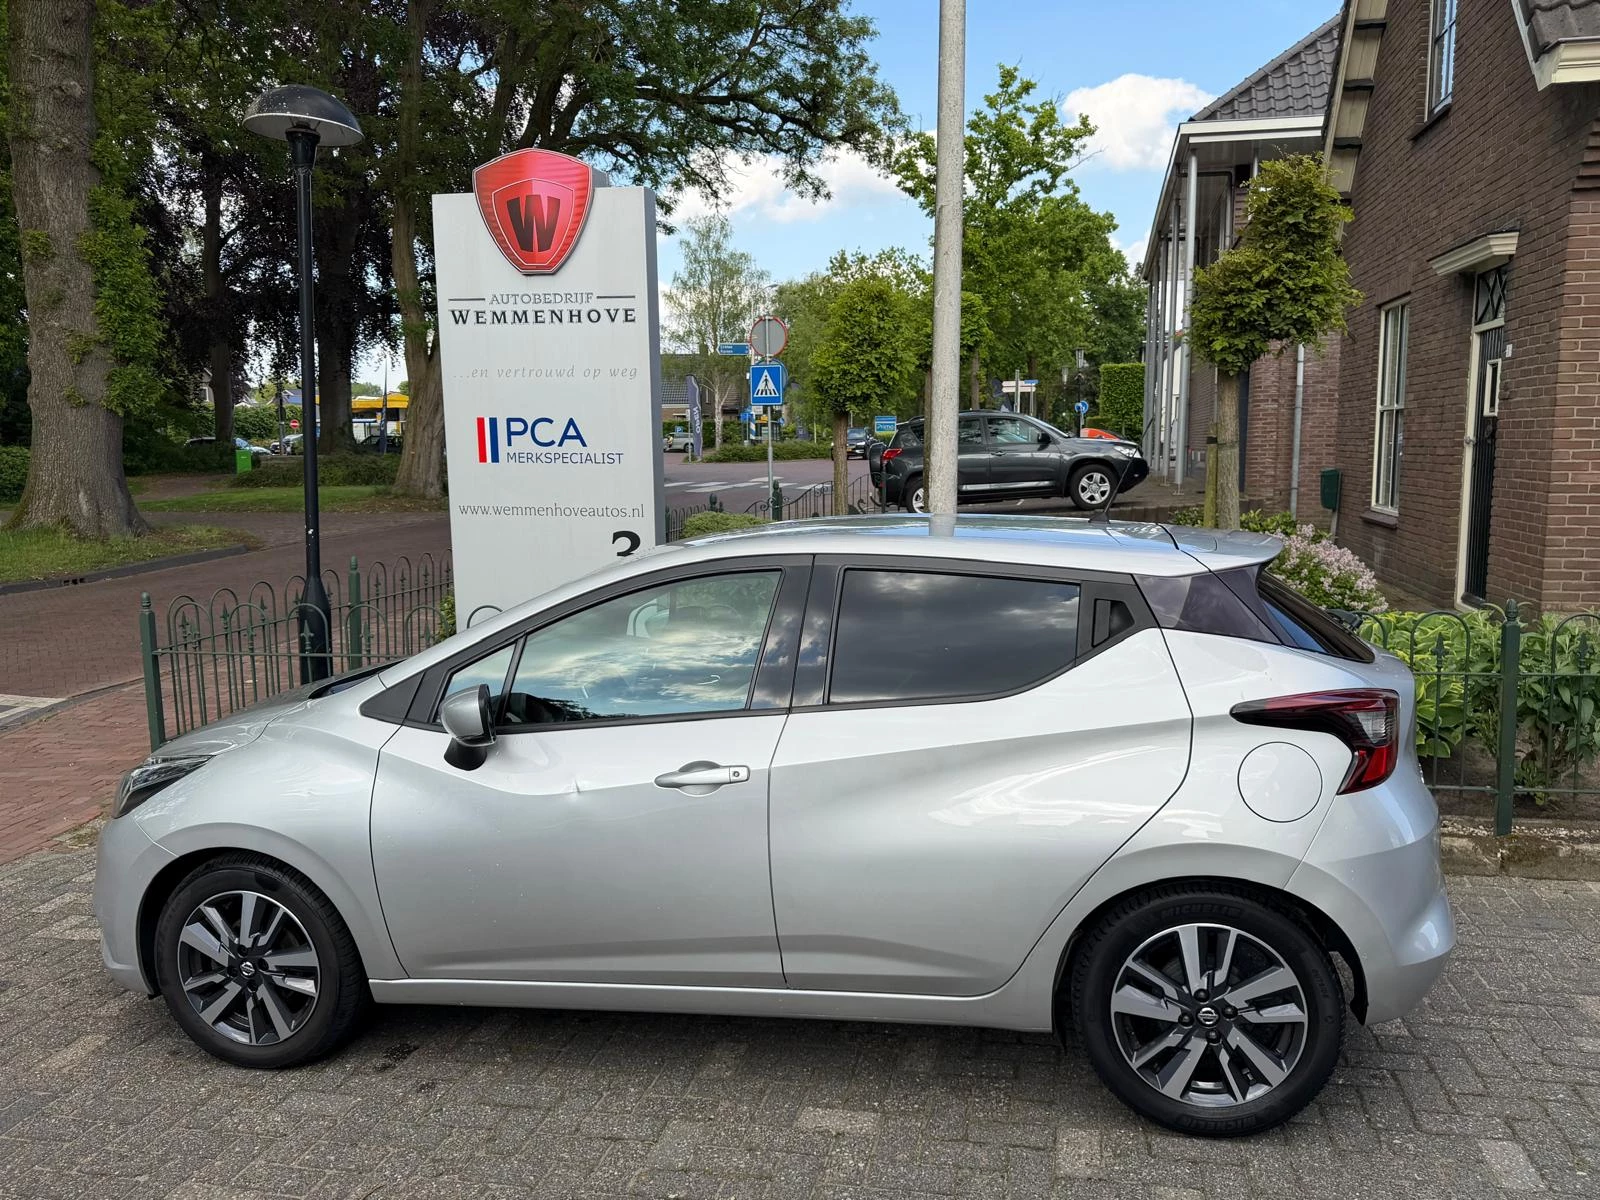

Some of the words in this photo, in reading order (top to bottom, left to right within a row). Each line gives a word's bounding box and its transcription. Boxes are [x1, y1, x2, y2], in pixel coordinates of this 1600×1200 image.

[506, 194, 561, 253] W
[489, 292, 594, 305] AUTOBEDRIJF
[450, 308, 636, 326] WEMMENHOVE
[497, 365, 576, 379] vertrouwd
[583, 367, 601, 381] op
[609, 367, 638, 380] weg
[506, 417, 588, 448] PCA
[506, 452, 624, 465] MERKSPECIALIST
[459, 503, 645, 518] www.wemmenhoveautos.nl
[1160, 903, 1242, 919] MICHELIN
